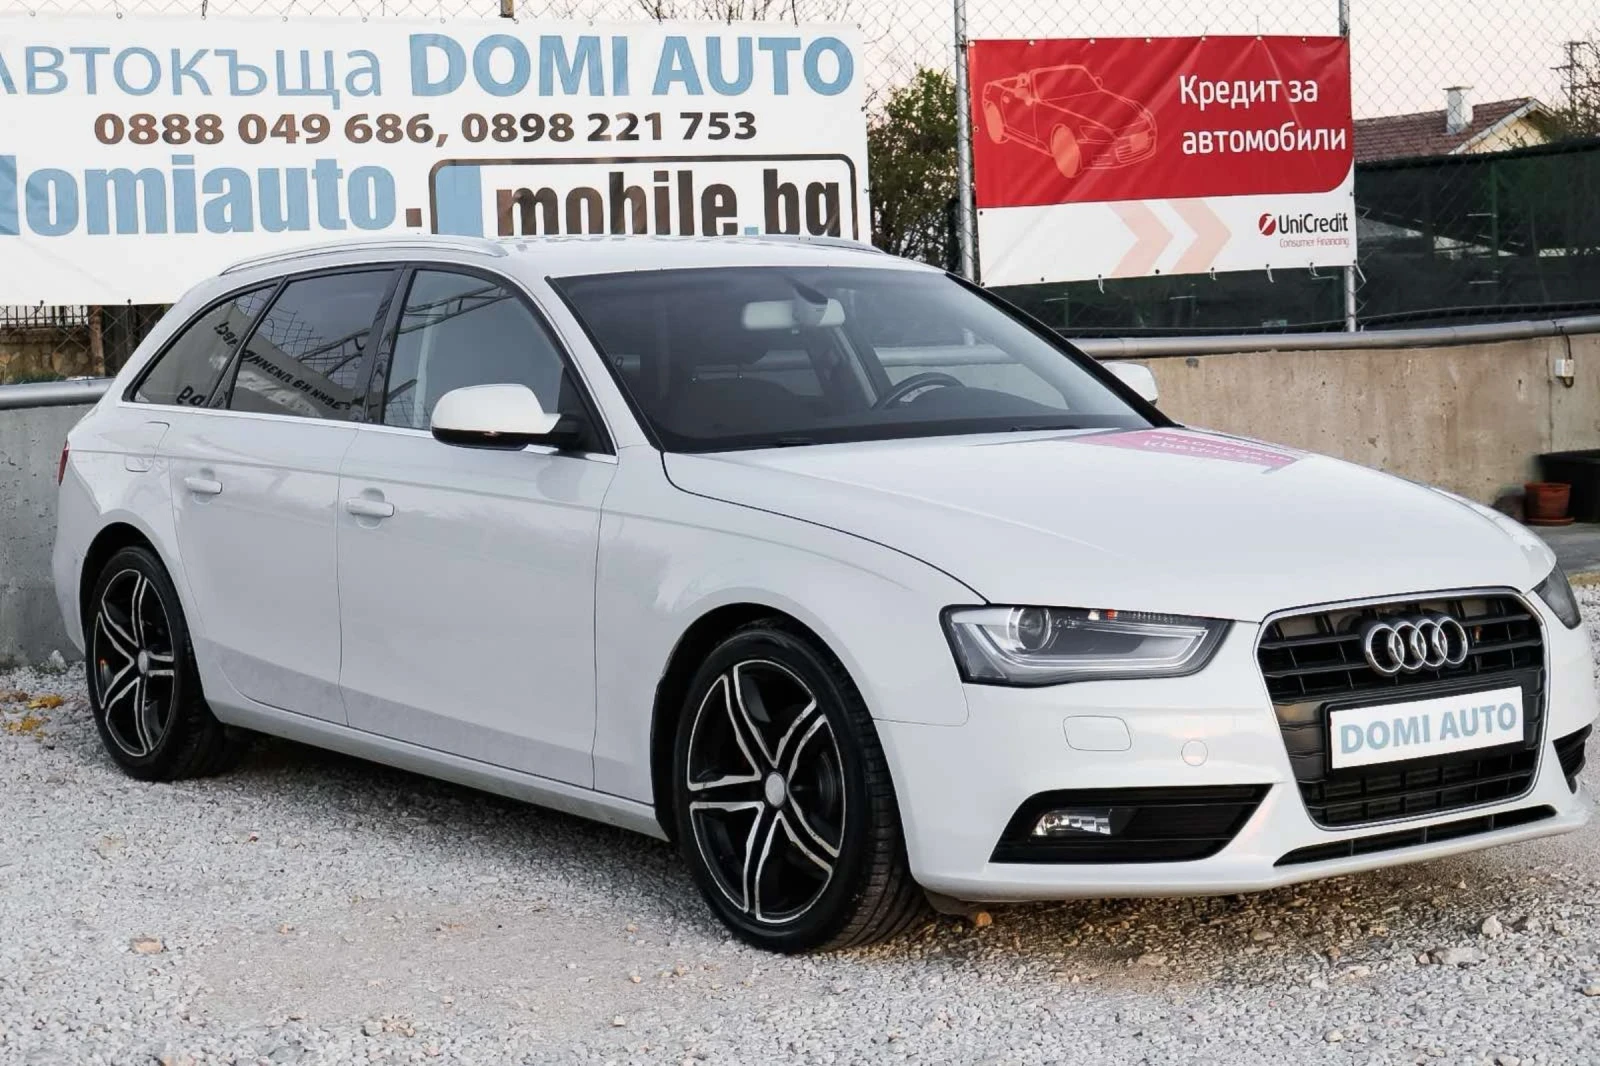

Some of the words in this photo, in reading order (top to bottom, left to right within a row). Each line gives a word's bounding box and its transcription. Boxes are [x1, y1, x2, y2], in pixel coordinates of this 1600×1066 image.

[409, 34, 629, 97] DOMI
[652, 36, 854, 96] AUTO
[1179, 74, 1281, 111] Кредит
[1289, 80, 1318, 102] за
[94, 113, 224, 145] 0888
[238, 113, 331, 144] 049
[345, 113, 448, 147] 686,
[462, 113, 574, 143] 0898
[587, 112, 662, 141] 221
[680, 111, 757, 140] 753
[1183, 121, 1346, 154] автомобили
[1279, 212, 1348, 234] UniCredit
[1280, 238, 1314, 248] Consumer
[1316, 237, 1349, 248] Financing
[1340, 714, 1430, 754] DOMI
[1440, 702, 1517, 740] AUTO
